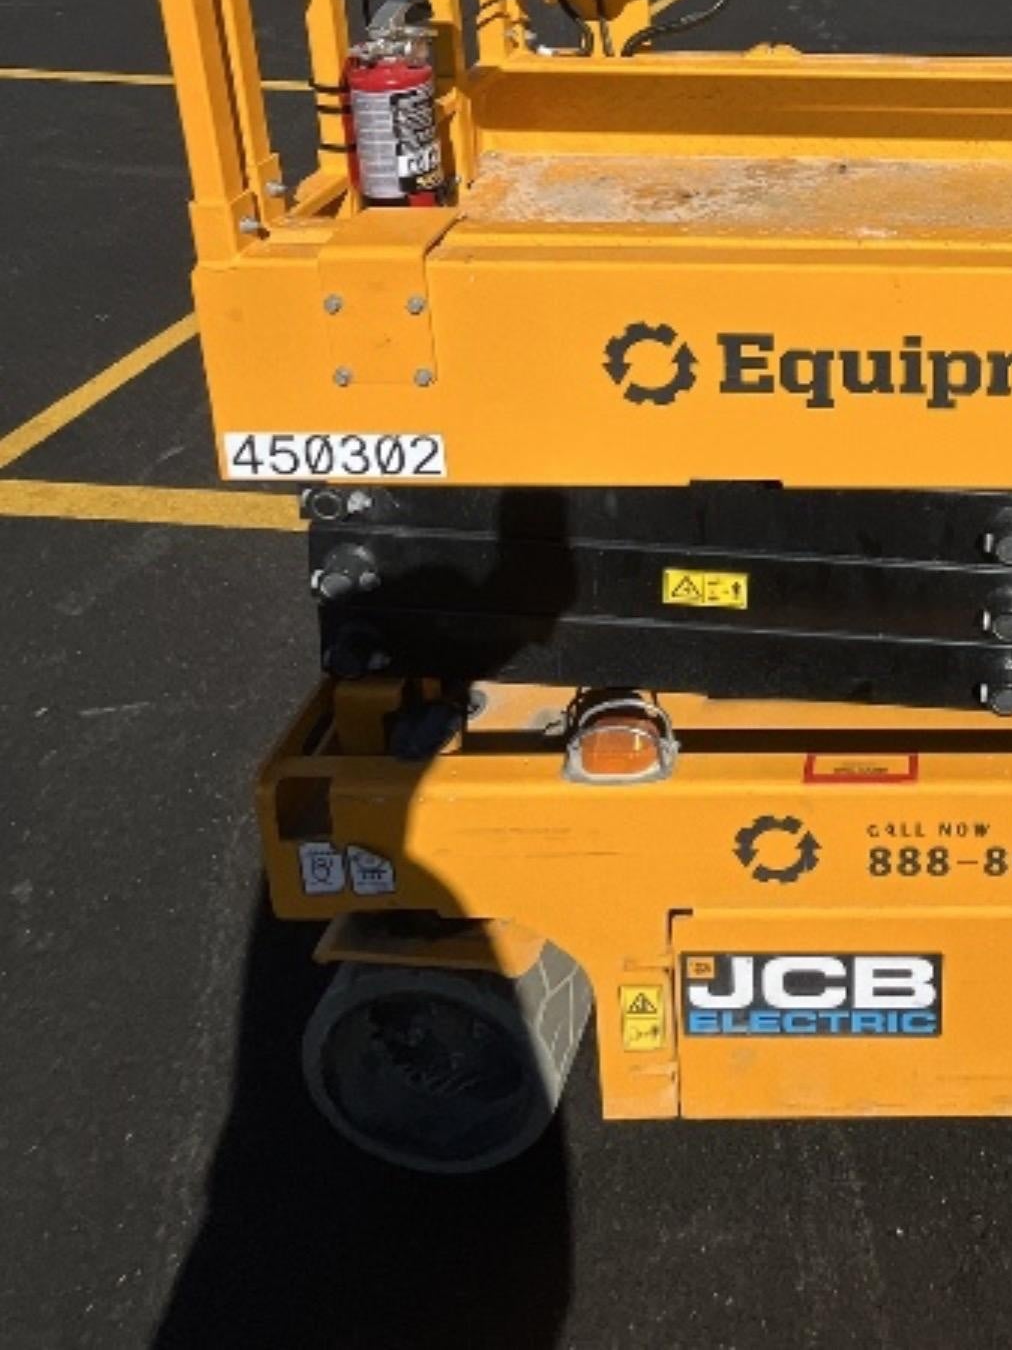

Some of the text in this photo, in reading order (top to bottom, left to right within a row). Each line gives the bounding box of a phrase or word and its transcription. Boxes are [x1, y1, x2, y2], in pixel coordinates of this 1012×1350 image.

[232, 434, 442, 475] 450302
[866, 822, 990, 838] CALL NOW
[688, 956, 936, 1009] JCB
[689, 1010, 937, 1034] ELECTRIC
